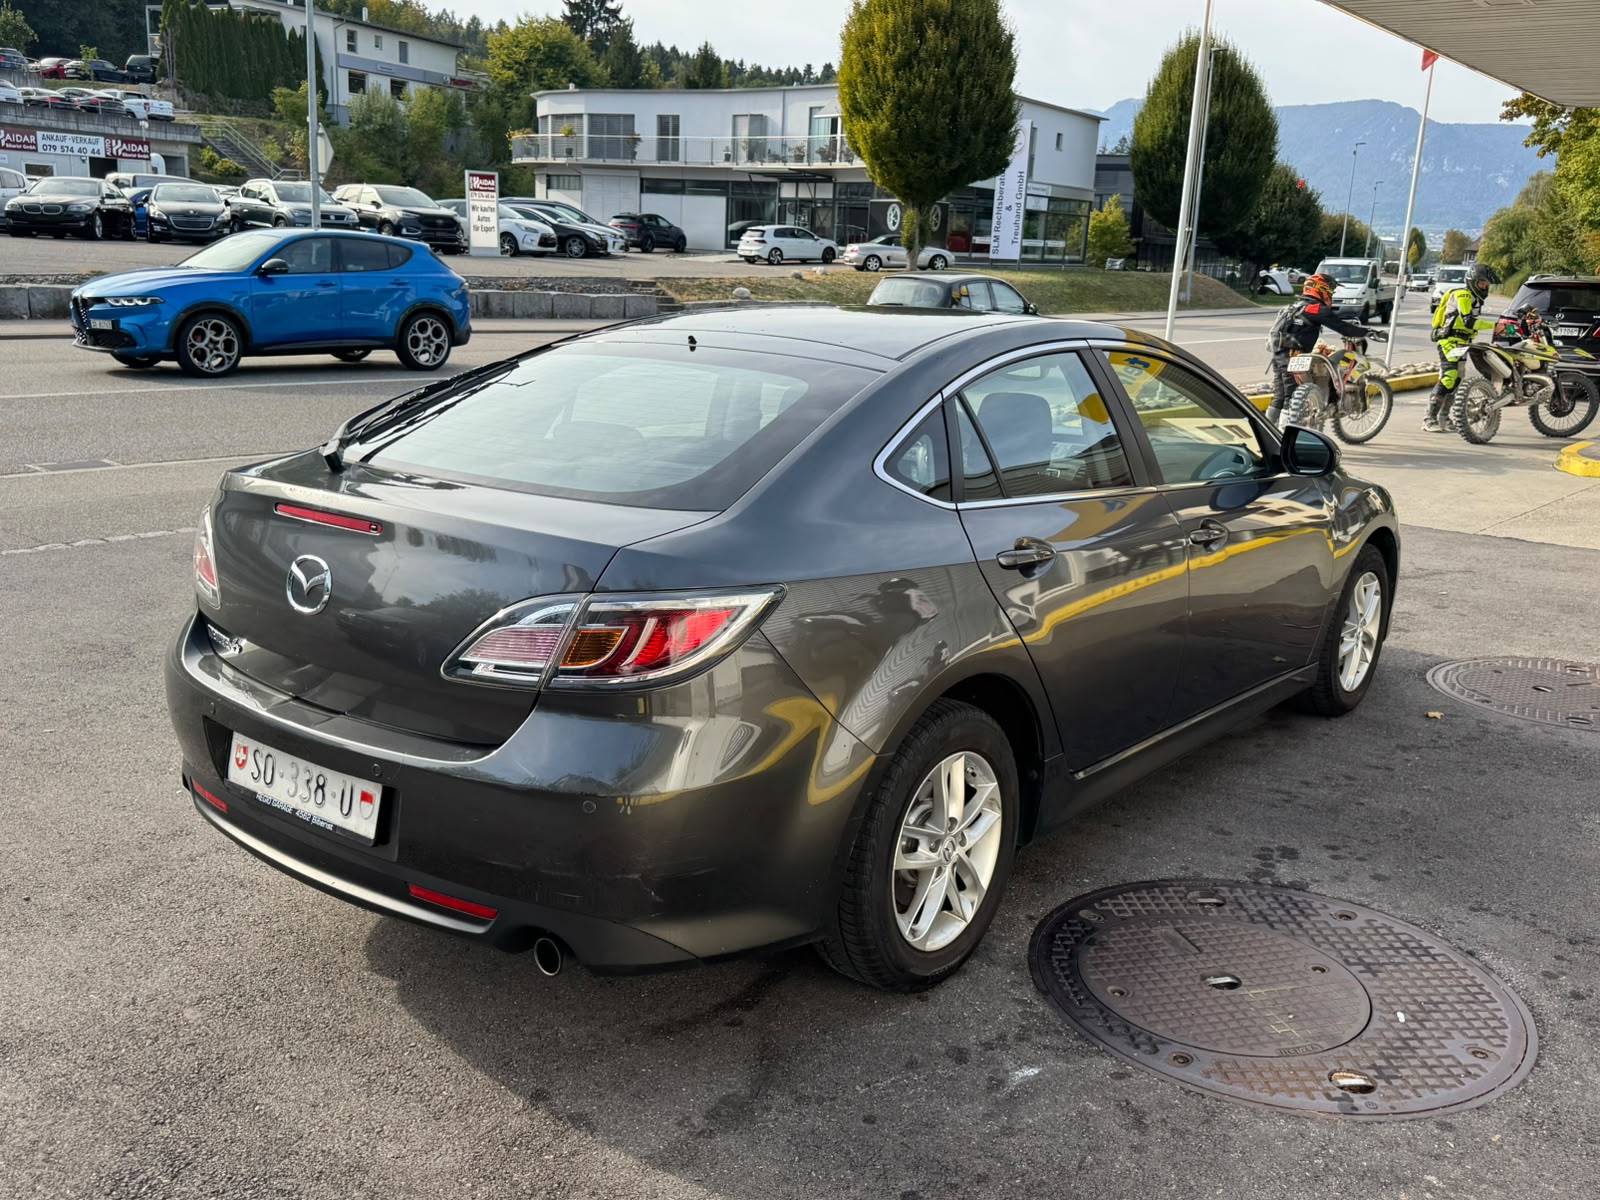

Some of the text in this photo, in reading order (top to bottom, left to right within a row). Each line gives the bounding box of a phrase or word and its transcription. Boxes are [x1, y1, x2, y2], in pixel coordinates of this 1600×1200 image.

[42, 144, 57, 153] 079
[60, 145, 74, 154] 574
[112, 139, 149, 156] HAIDAR
[1005, 204, 1012, 212] &
[1011, 171, 1025, 245] Treuhand GmbH
[480, 225, 495, 234] Export
[992, 235, 1000, 255] SLM
[271, 799, 293, 814] GARAGE
